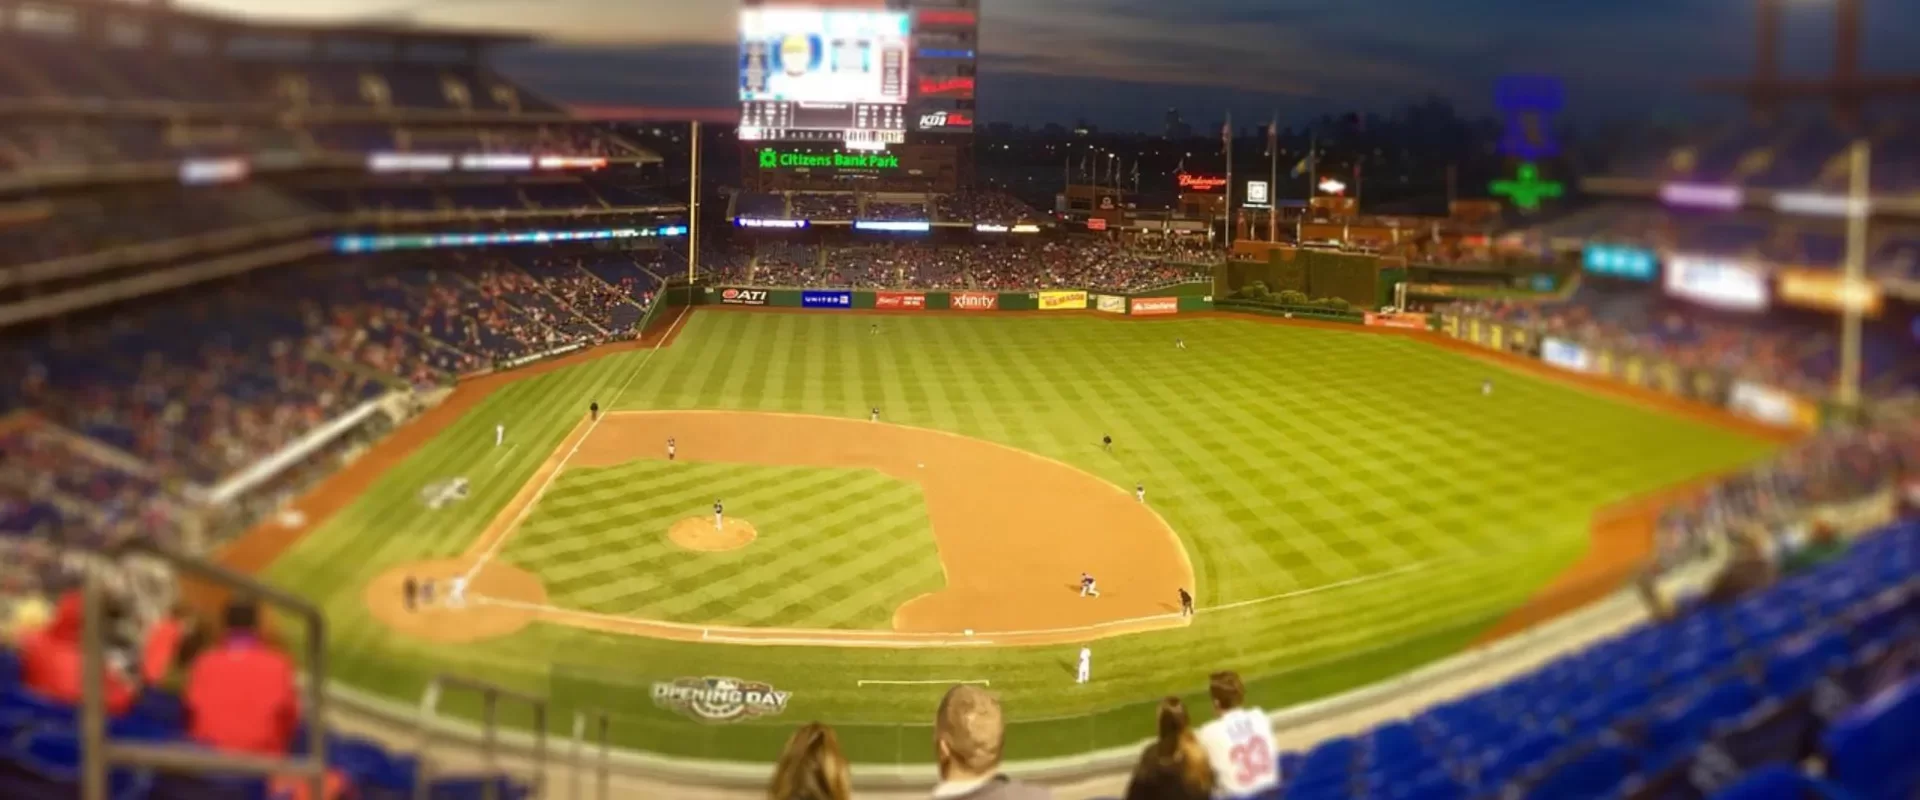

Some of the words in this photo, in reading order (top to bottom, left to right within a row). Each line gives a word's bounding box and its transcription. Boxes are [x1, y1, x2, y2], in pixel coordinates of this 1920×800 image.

[780, 153, 831, 166] Citizens
[834, 154, 867, 166] Bank
[869, 155, 898, 168] Park
[1179, 174, 1226, 186] Budweiser
[738, 290, 767, 300] ATI
[953, 294, 995, 308] xfinity
[653, 682, 742, 702] OPENING
[745, 690, 788, 705] DAY
